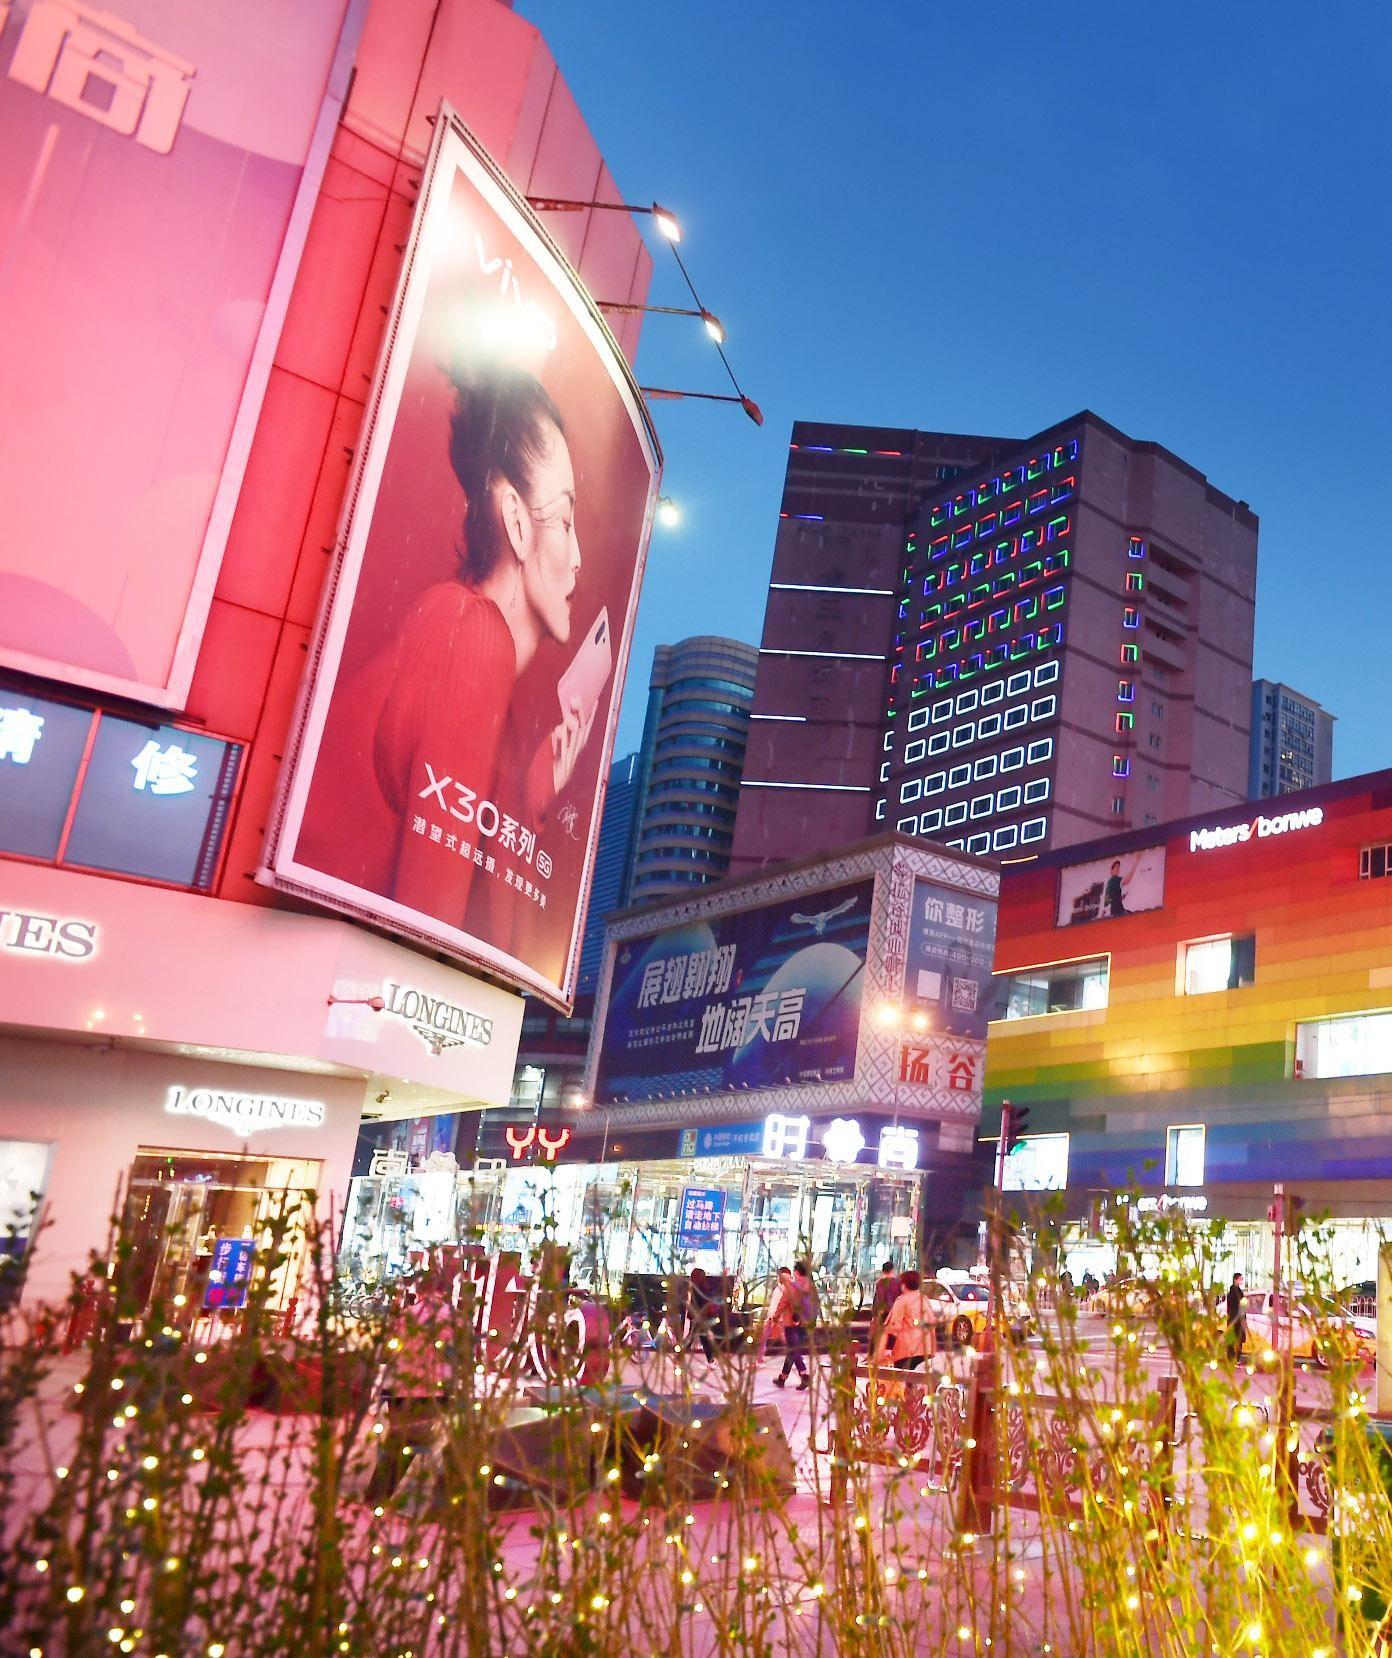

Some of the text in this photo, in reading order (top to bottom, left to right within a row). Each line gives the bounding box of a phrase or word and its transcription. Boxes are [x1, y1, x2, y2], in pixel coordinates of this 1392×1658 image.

[472, 231, 558, 351] viv
[418, 762, 536, 865] X30系列
[638, 944, 737, 1009] 展翅翱翔
[389, 983, 494, 1046] LONGINES
[695, 988, 807, 1054] 地阔天高
[172, 1090, 323, 1124] LONGINES
